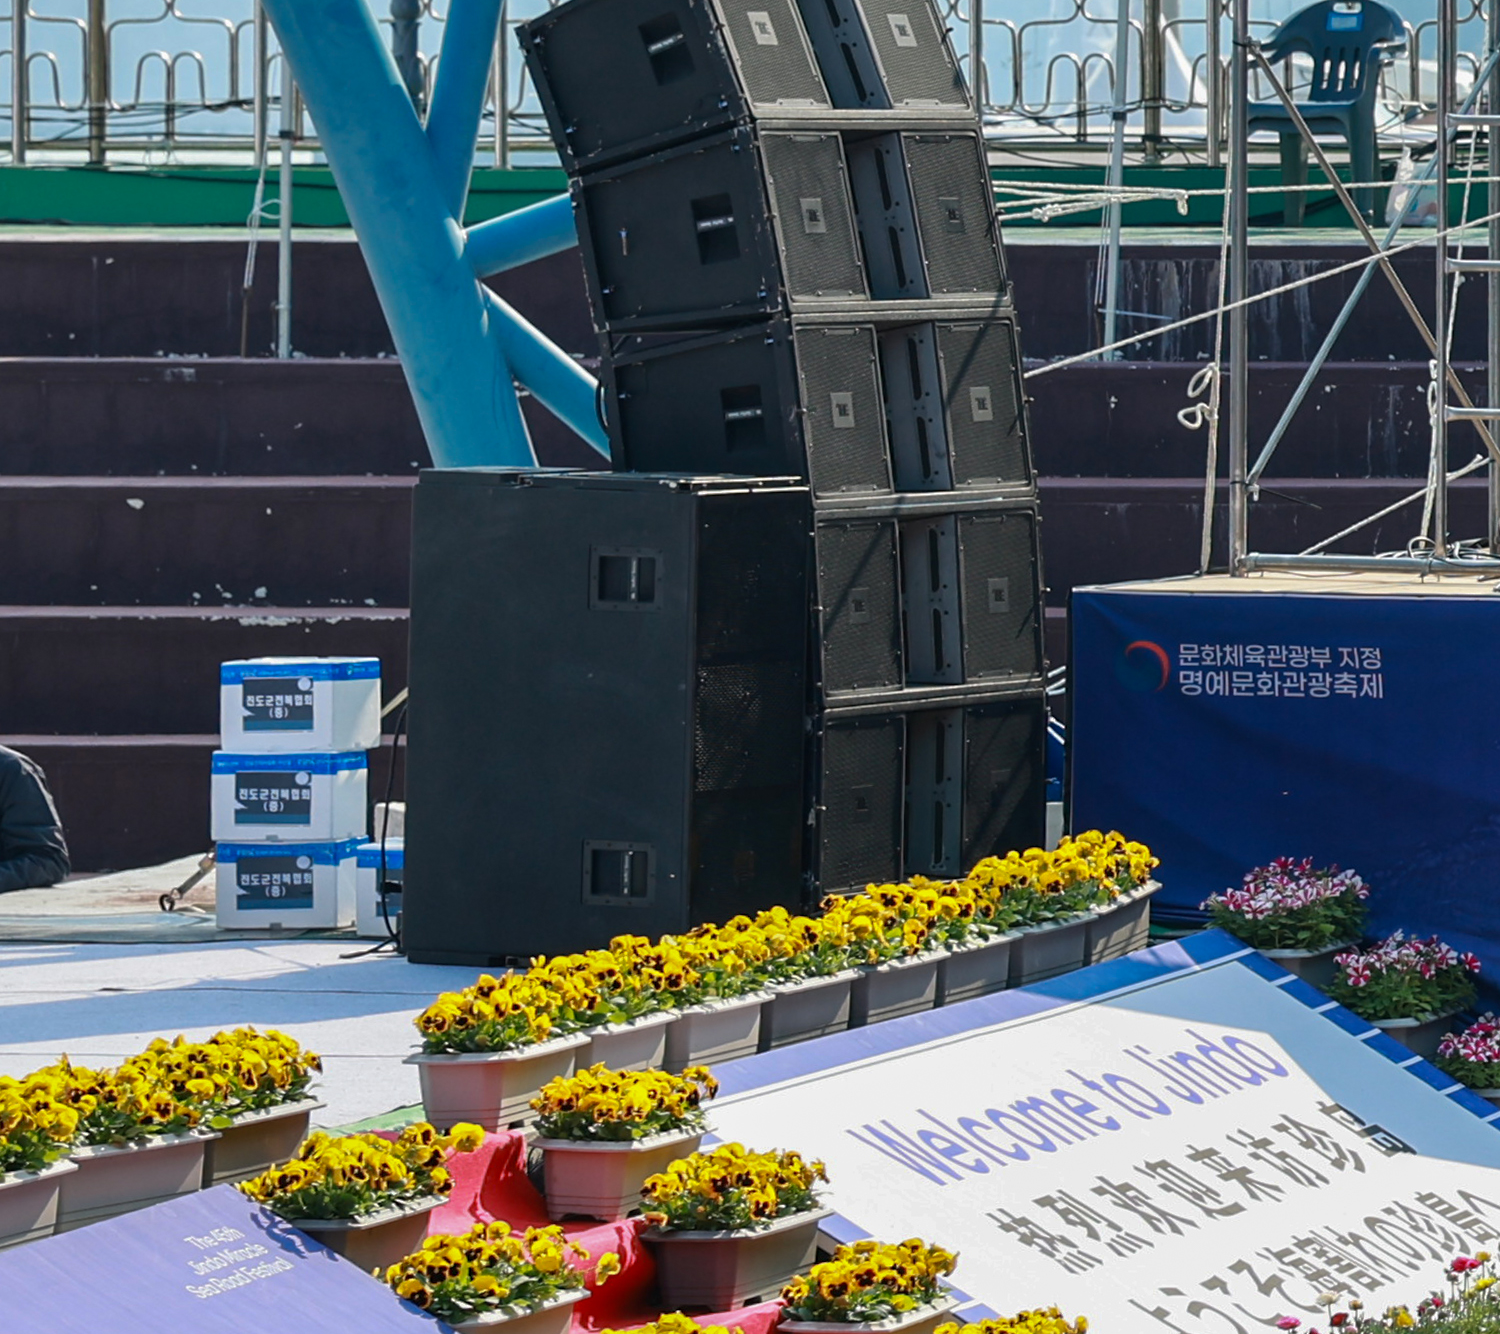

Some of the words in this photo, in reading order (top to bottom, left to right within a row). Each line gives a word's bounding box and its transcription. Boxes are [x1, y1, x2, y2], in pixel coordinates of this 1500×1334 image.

[1178, 643, 1333, 669] 문화체육관광부
[1337, 646, 1383, 670] 지정
[1178, 670, 1384, 699] 명예문화관광축제
[845, 1077, 1122, 1187] Welcome
[1065, 1069, 1173, 1121] to
[1122, 1028, 1290, 1105] Jindo
[986, 1099, 1418, 1277] 热烈欢迎来访珍岛
[183, 1234, 219, 1250] The
[185, 1275, 222, 1299] Sea
[209, 1270, 252, 1293] Road
[241, 1256, 295, 1281] Festival
[187, 1252, 230, 1276] Jindo
